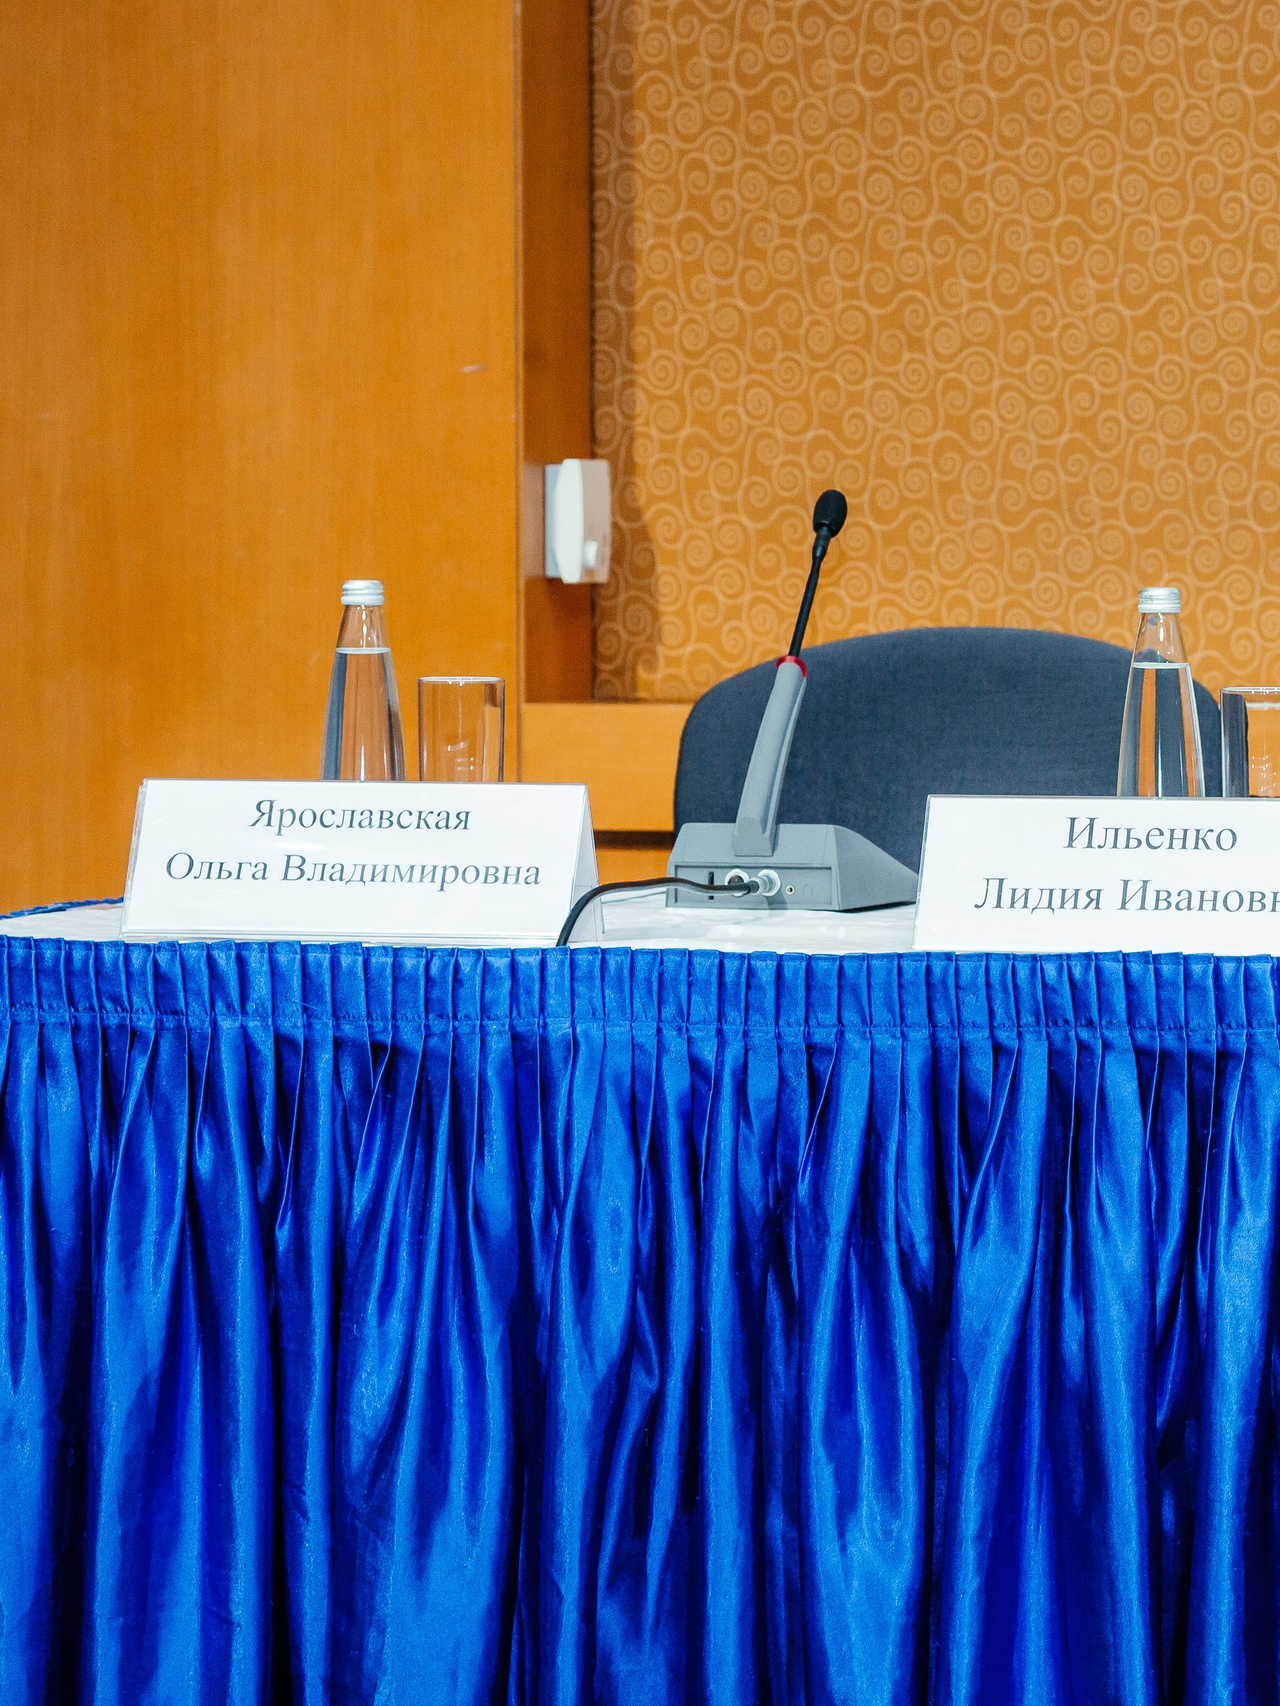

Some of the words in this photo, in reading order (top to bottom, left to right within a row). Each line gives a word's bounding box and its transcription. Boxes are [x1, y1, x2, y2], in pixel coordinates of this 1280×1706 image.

[248, 798, 472, 836] Ярославская
[1062, 816, 1239, 852] Ильенко
[165, 851, 269, 882] Ольга
[279, 853, 542, 893] Владимировна
[973, 876, 1104, 915] Лидия
